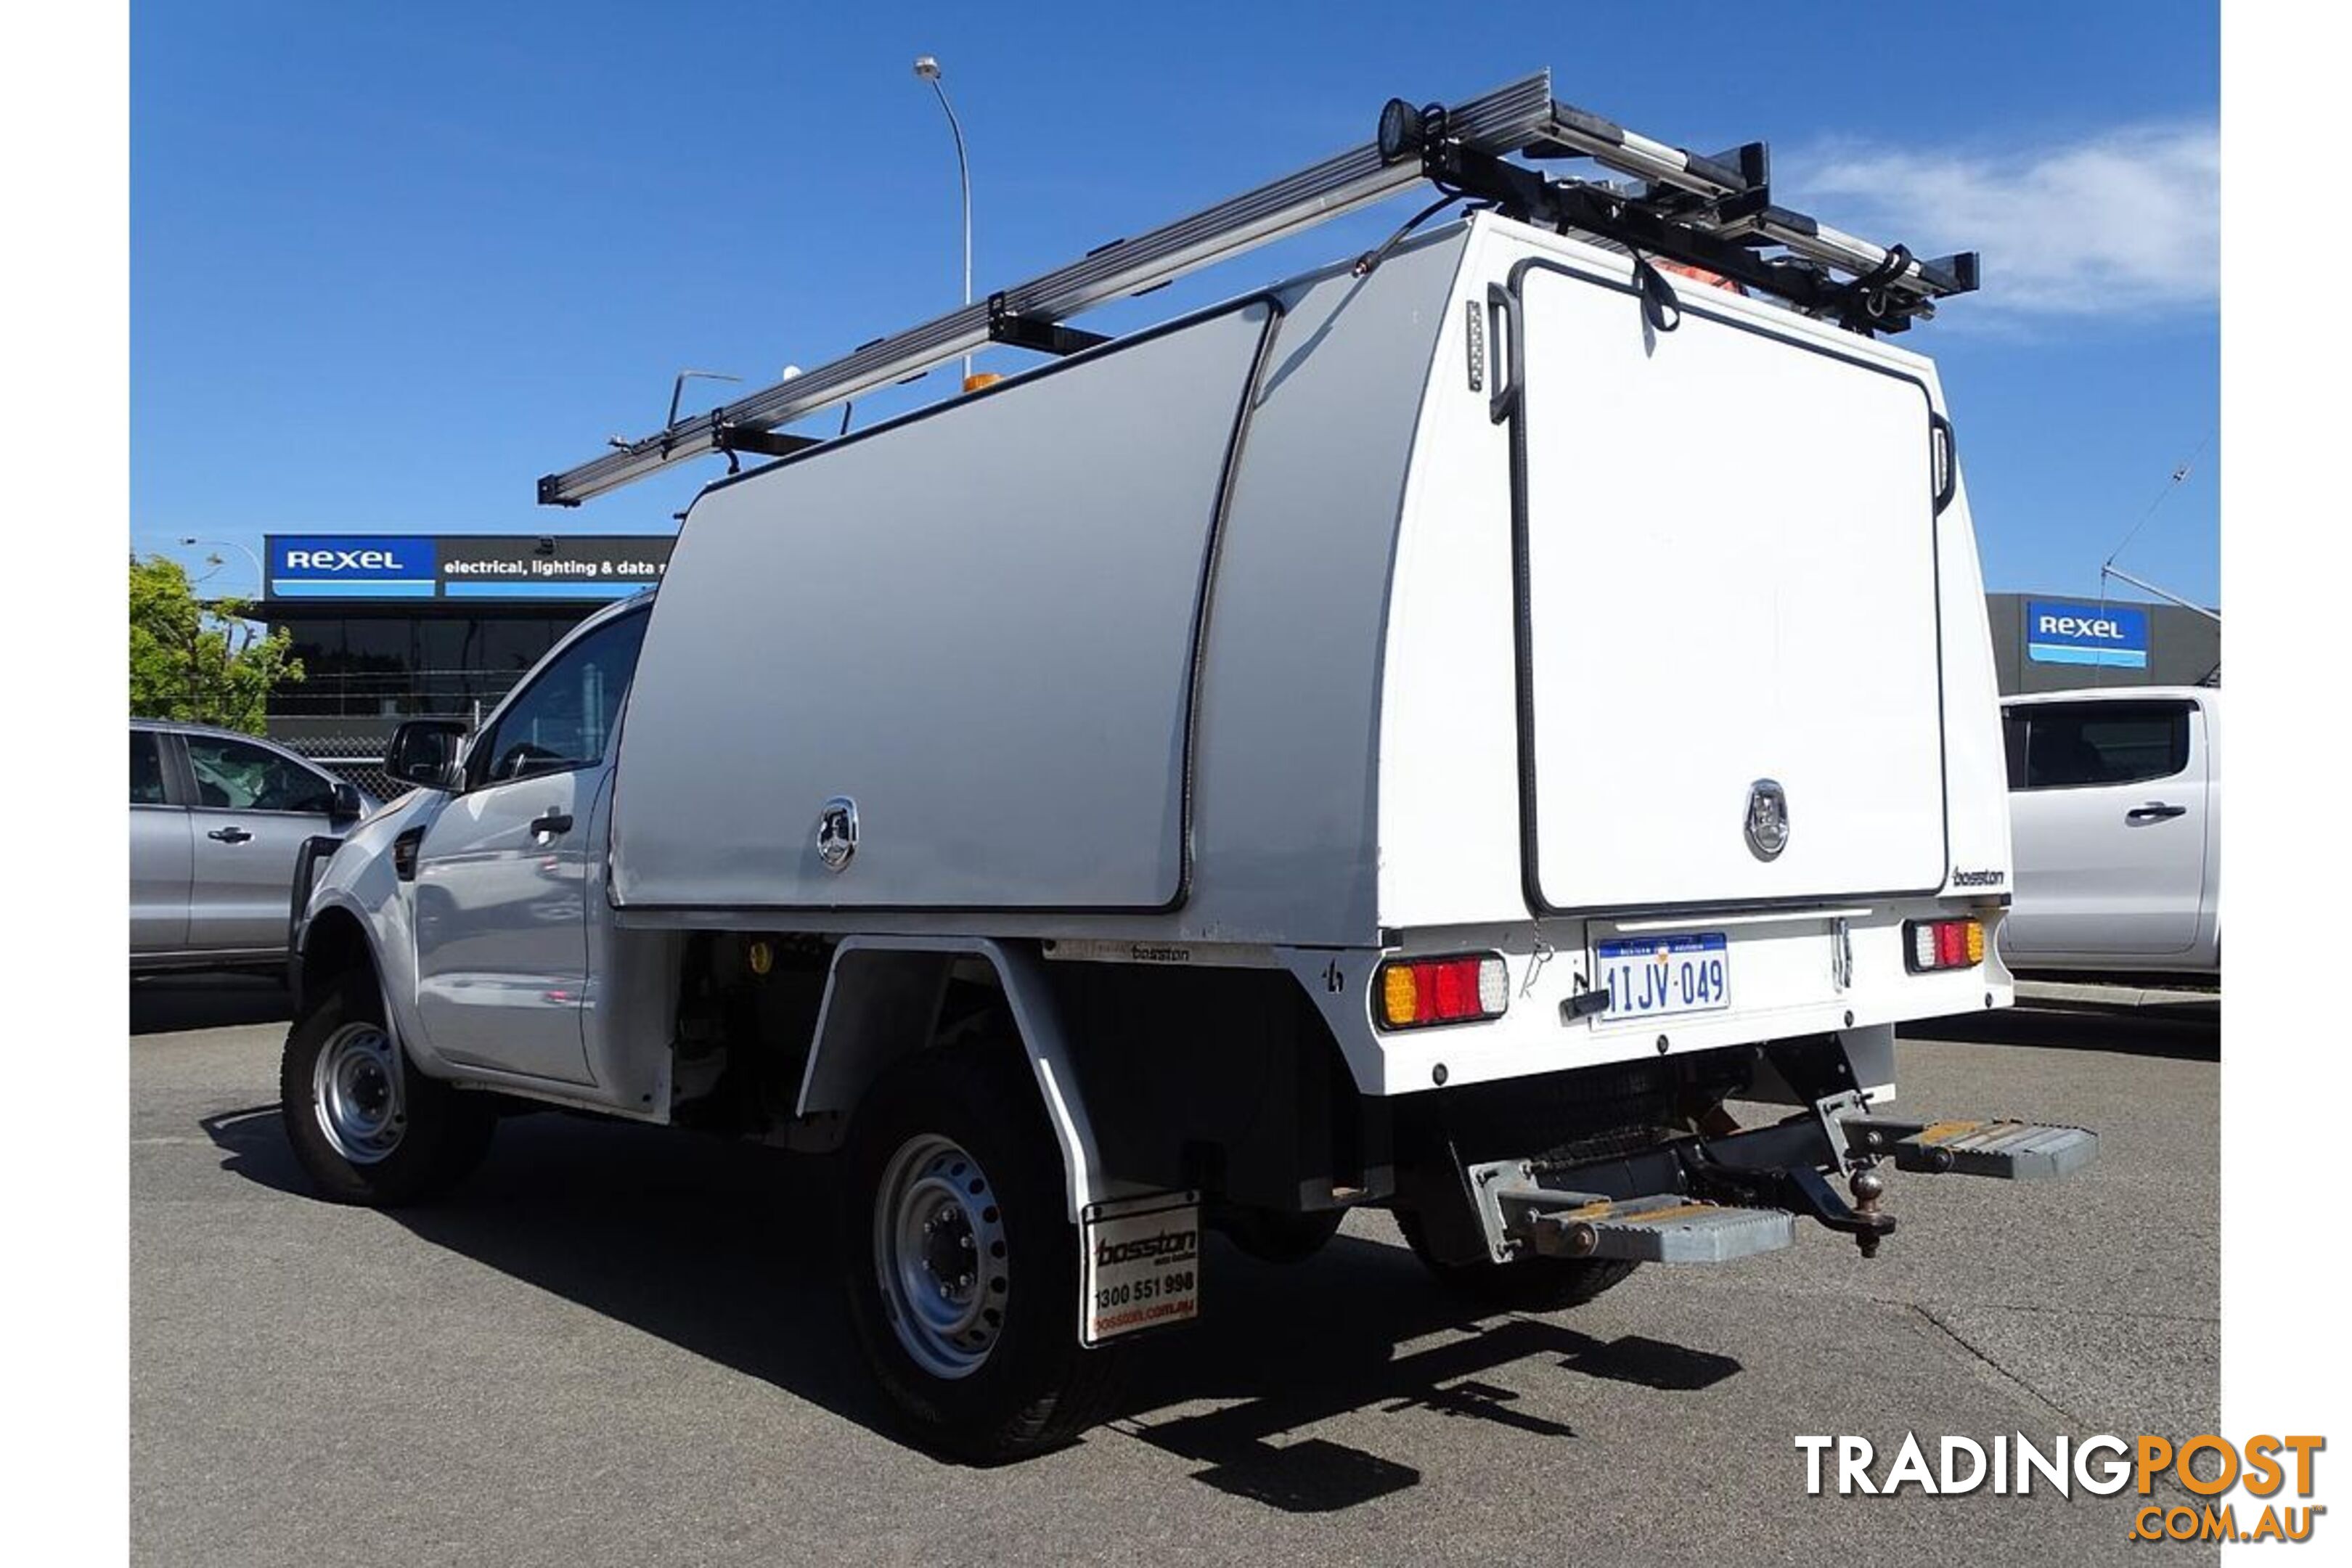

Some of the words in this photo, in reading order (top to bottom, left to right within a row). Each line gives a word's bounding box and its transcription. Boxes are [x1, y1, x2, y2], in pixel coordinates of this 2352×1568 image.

[444, 560, 528, 576] electrical,
[532, 560, 597, 576] lighting
[601, 562, 613, 574] &
[617, 560, 655, 574] data
[1095, 1228, 1196, 1267] bosston
[1095, 1282, 1130, 1310] 1300
[1133, 1278, 1160, 1301] 551
[1164, 1271, 1194, 1294] 998
